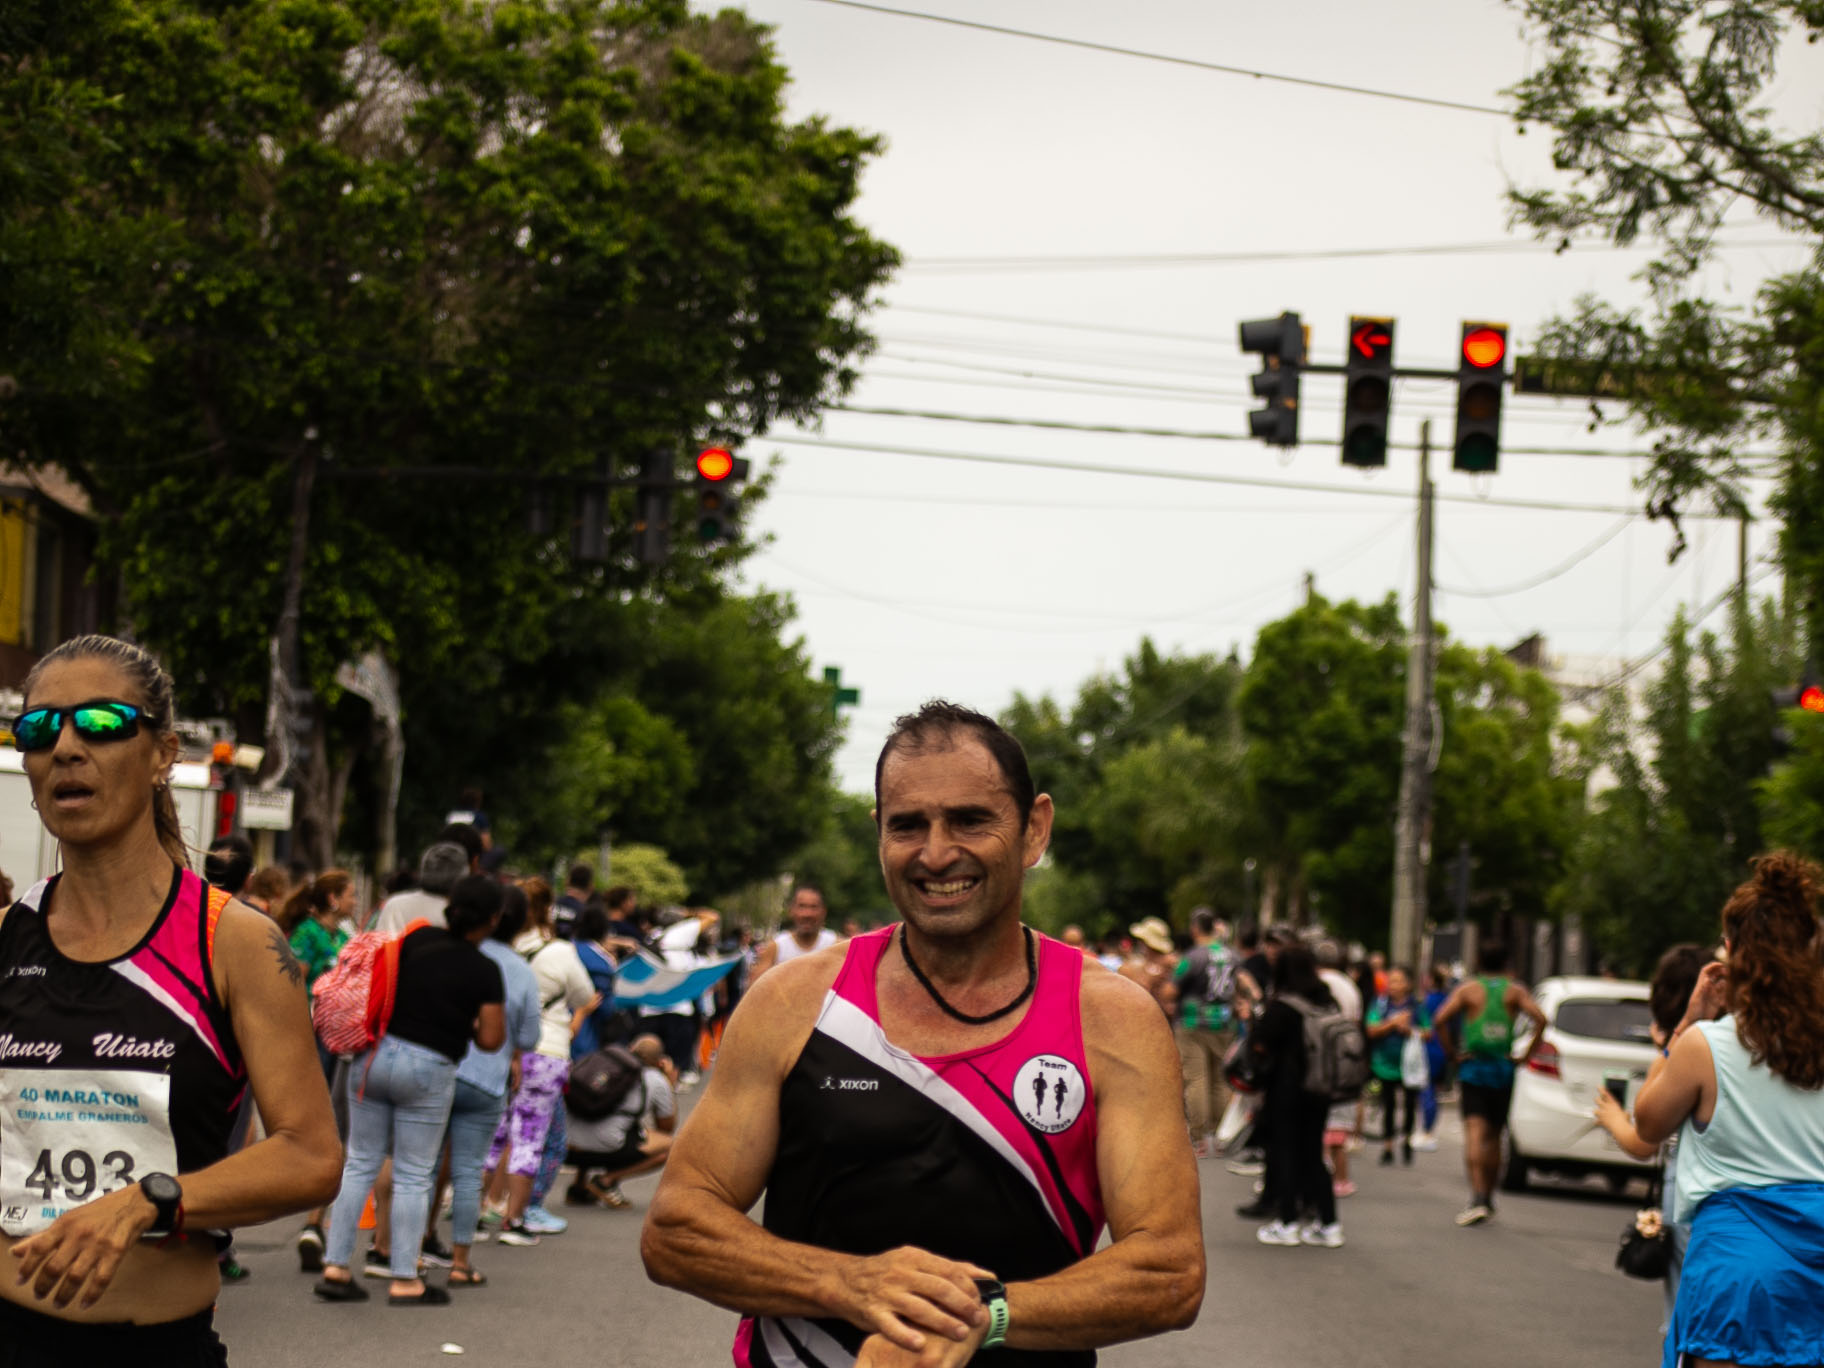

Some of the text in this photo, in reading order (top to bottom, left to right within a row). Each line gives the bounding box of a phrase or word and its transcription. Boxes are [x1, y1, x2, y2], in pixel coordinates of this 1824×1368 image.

[1038, 1058, 1068, 1071] Team
[19, 1087, 140, 1108] 40 MARATON
[17, 1108, 150, 1124] EMPALME GRANEROS
[25, 1148, 137, 1201] 493
